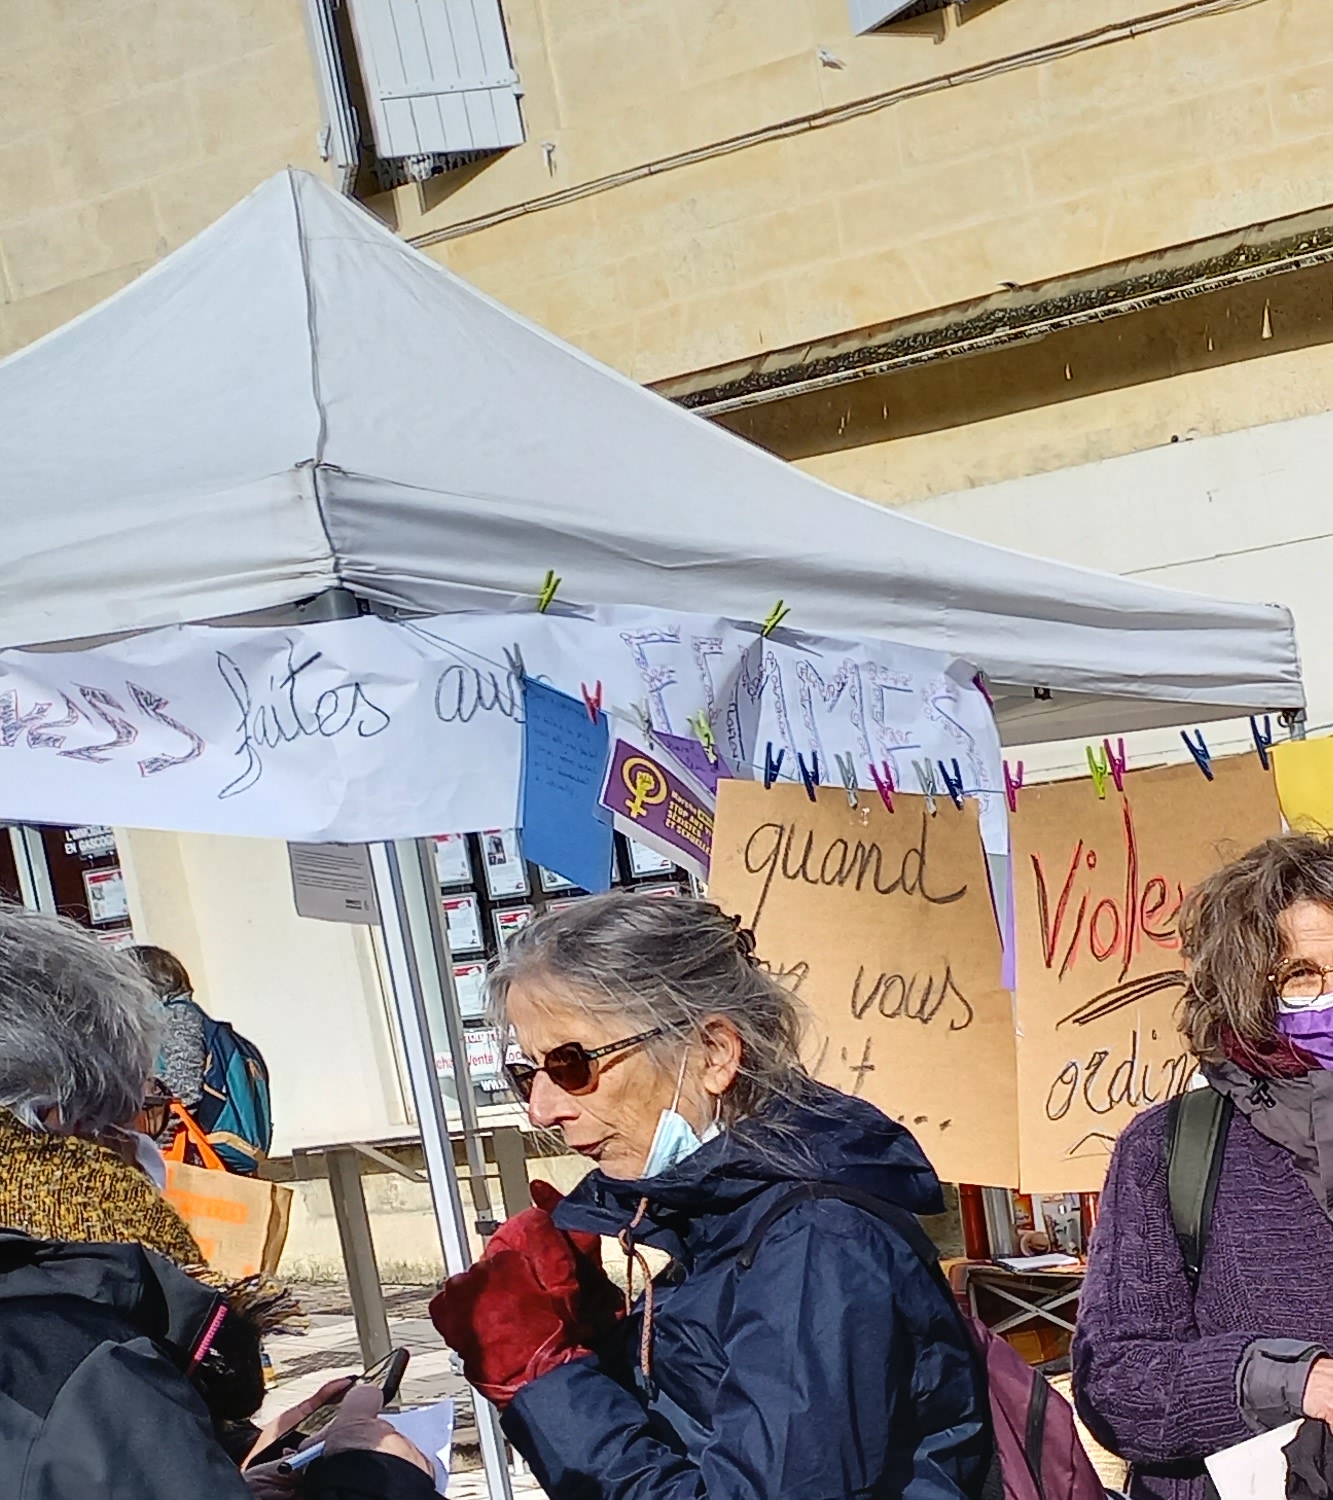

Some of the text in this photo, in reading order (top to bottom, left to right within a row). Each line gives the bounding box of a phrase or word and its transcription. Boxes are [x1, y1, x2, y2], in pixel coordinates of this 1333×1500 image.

[215, 637, 392, 800] faites
[669, 800, 690, 819] STOP
[744, 812, 968, 937] quand
[850, 964, 975, 1032] vous
